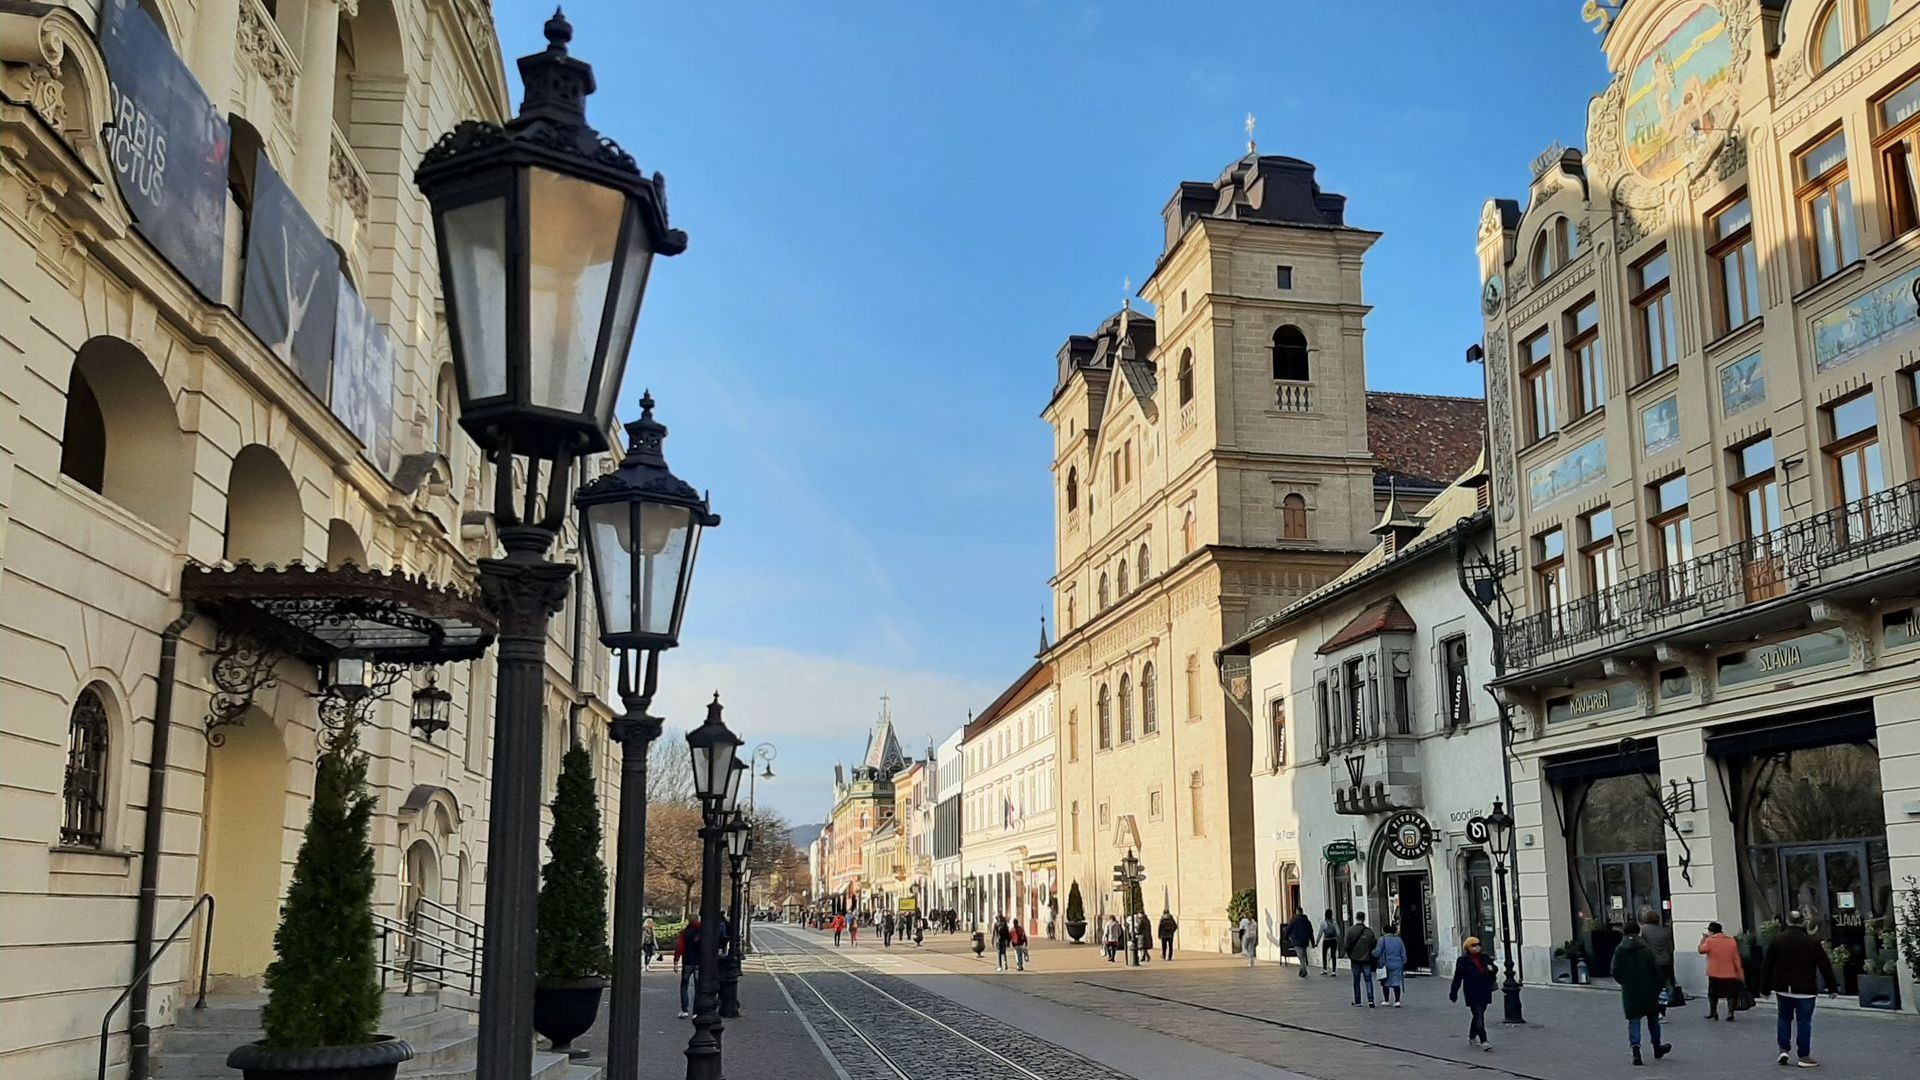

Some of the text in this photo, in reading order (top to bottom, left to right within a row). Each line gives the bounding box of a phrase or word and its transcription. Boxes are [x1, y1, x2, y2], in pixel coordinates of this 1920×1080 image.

[105, 127, 163, 206] ICTUS
[1758, 645, 1801, 673] SLAVIA
[1453, 674, 1462, 720] BILIARD
[1392, 814, 1426, 829] PIVOVAR
